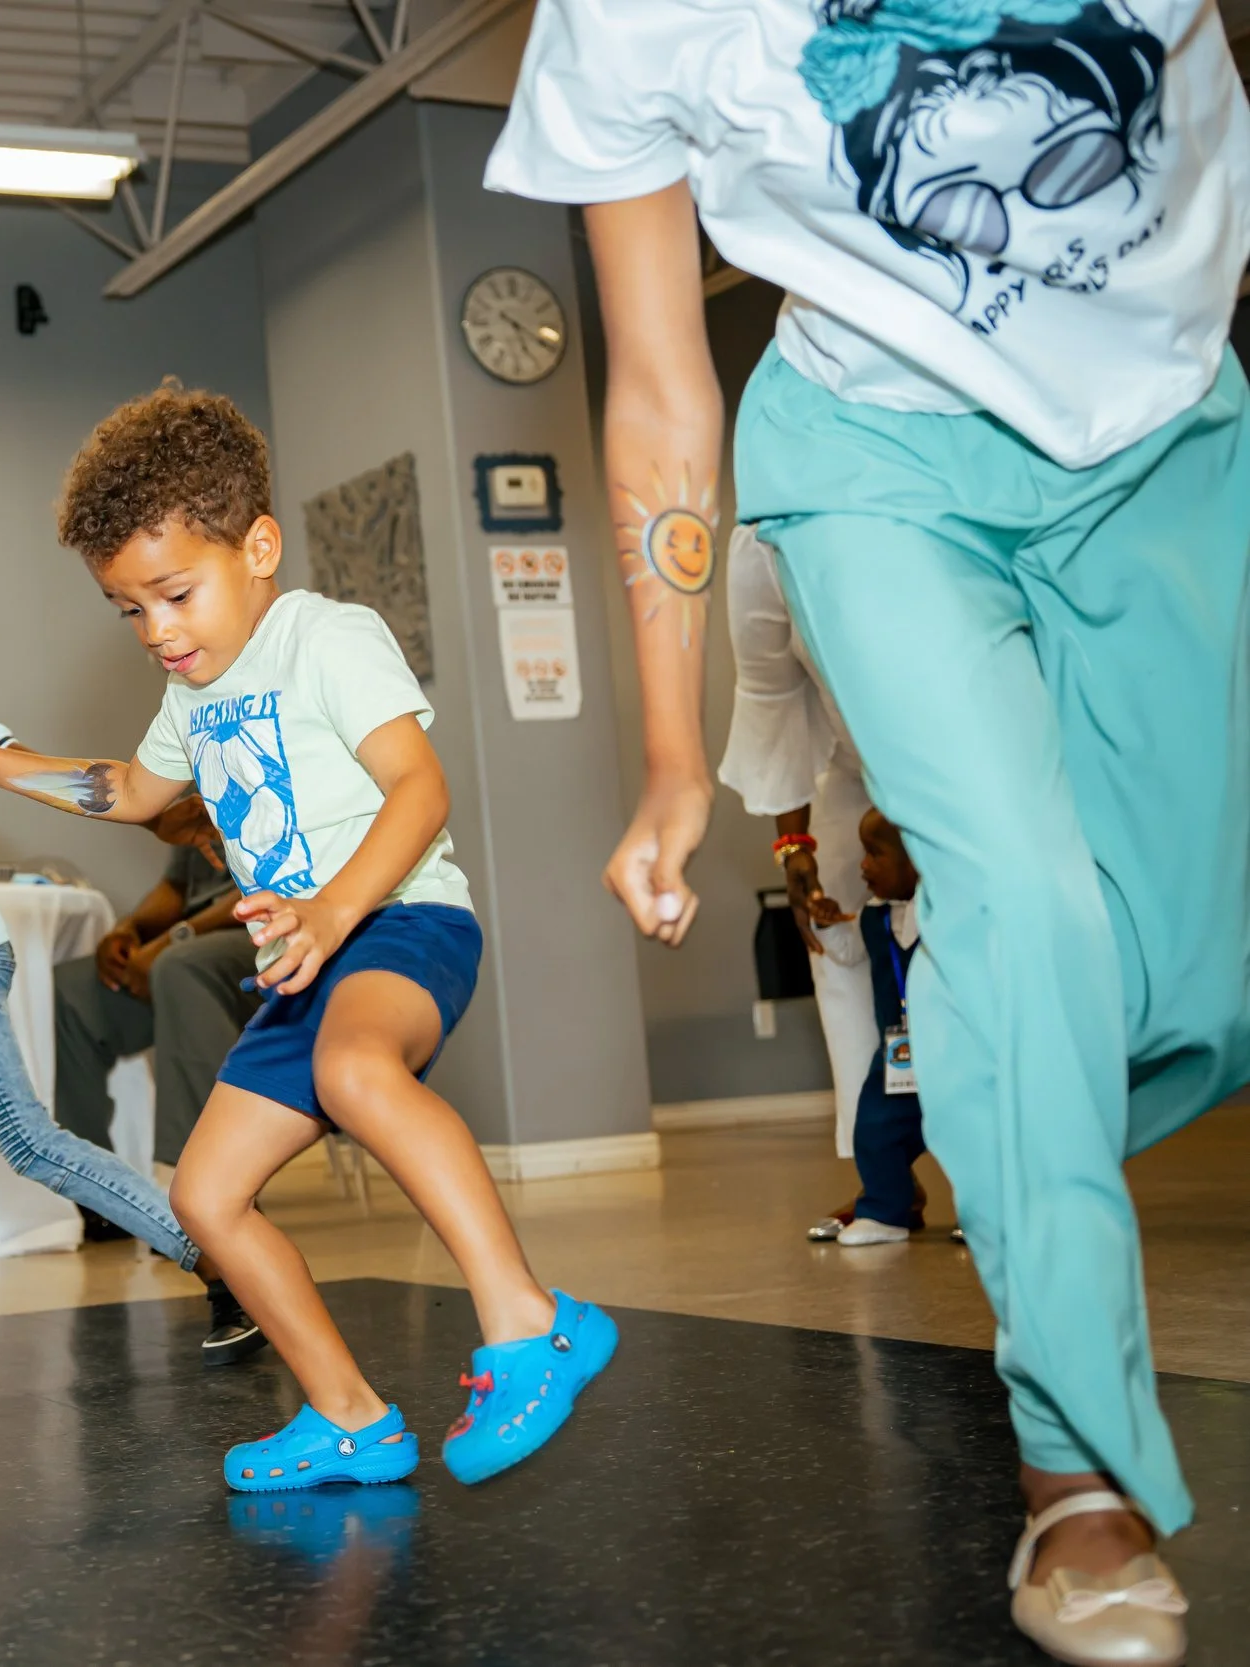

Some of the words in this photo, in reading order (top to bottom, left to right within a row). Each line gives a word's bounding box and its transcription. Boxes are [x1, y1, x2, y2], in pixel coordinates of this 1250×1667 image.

[1118, 207, 1166, 259] DAY
[971, 278, 1026, 336] APPY
[190, 694, 256, 732] KICKING
[259, 690, 282, 717] IT
